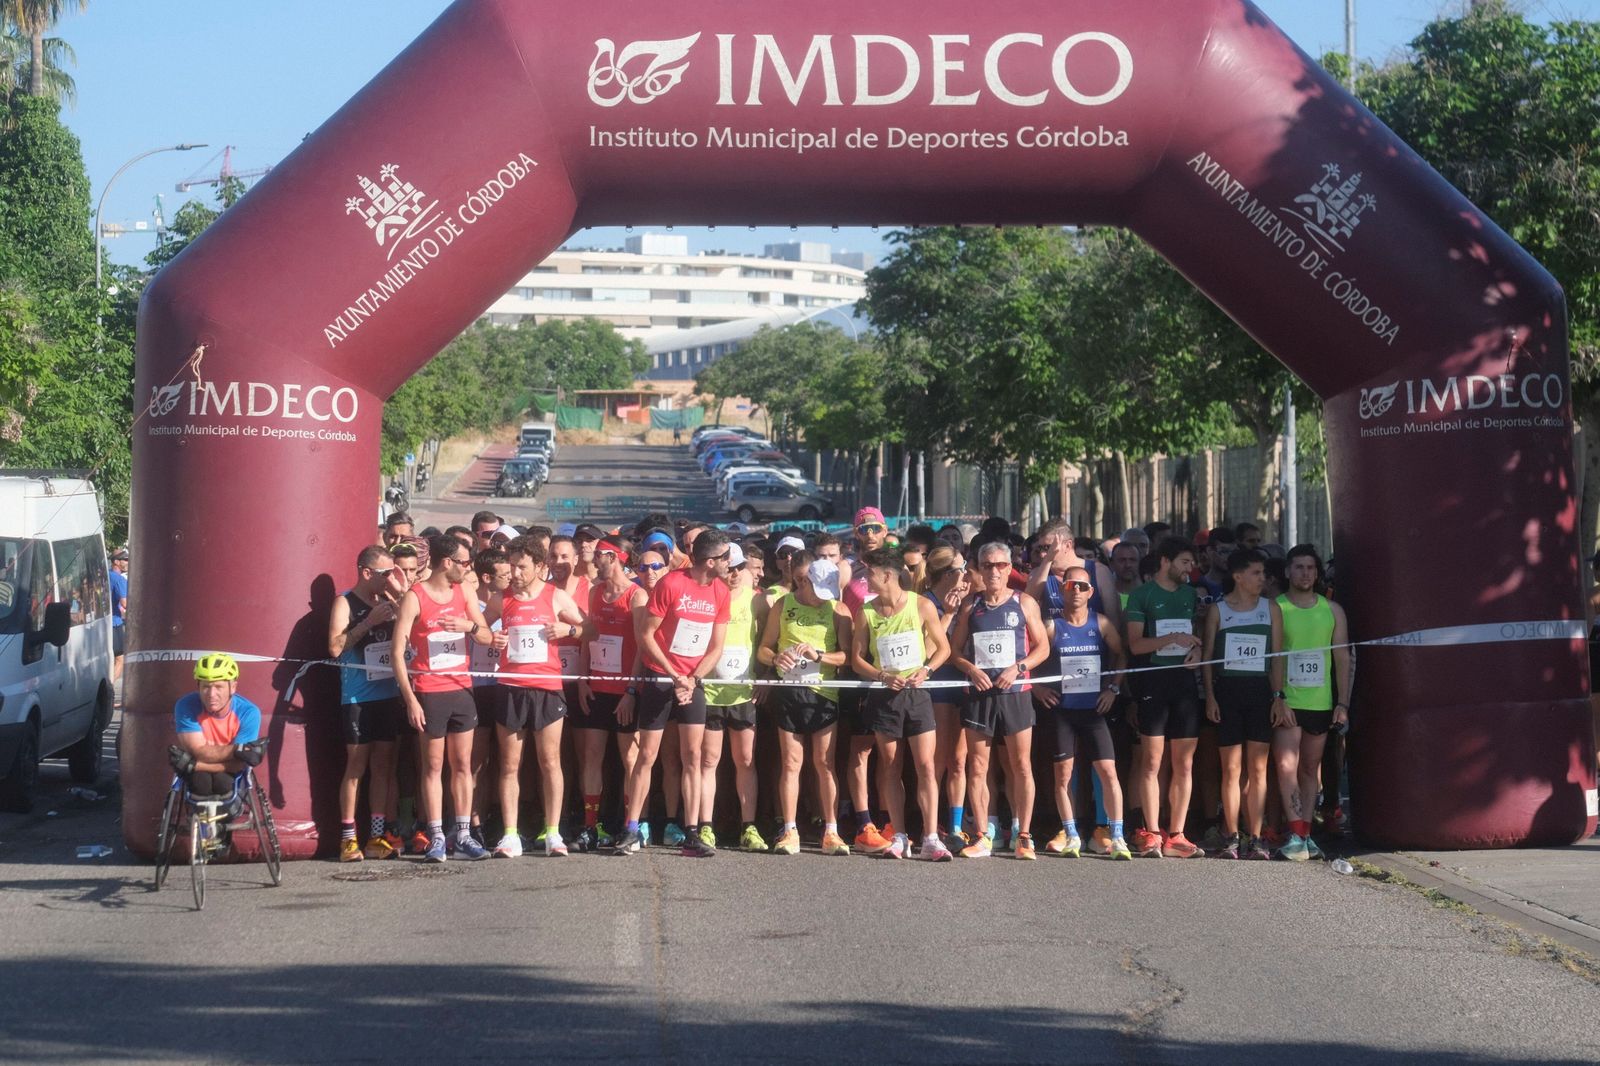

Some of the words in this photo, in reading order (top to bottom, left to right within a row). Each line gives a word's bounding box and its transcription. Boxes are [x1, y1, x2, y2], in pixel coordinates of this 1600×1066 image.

[714, 31, 1134, 107] IMDECO
[589, 124, 698, 149] Instituto
[705, 125, 837, 154] Municipal
[845, 125, 879, 149] de
[886, 126, 1009, 154] Deportes
[1016, 124, 1130, 148] Córdoba
[323, 238, 440, 349] AYUNTAMIENTO
[434, 217, 464, 246] DE
[458, 152, 539, 224] CÓRDOBA
[1185, 151, 1306, 258] AYUNTAMIENTO
[1300, 250, 1329, 279] DE
[1323, 271, 1401, 346] CÓRDOBA
[1405, 372, 1564, 414] IMDECO
[188, 380, 359, 423] IMDECO
[148, 424, 182, 436] Instituto
[184, 424, 240, 437] Municipal
[242, 425, 259, 437] de
[262, 426, 316, 440] Deportes
[317, 428, 357, 442] Córdoba
[1360, 425, 1401, 438] Instituto
[1403, 420, 1462, 434] Municipal
[1465, 418, 1480, 430] de
[1483, 416, 1532, 431] Deportes
[520, 637, 535, 649] 13
[691, 633, 700, 644] 3
[443, 642, 456, 654] 34
[890, 644, 910, 658] 137
[988, 643, 1002, 654] 69
[1060, 644, 1100, 653] TROTASIERRA
[1236, 645, 1257, 657] 140
[726, 658, 740, 669] 42
[1299, 662, 1319, 673] 139
